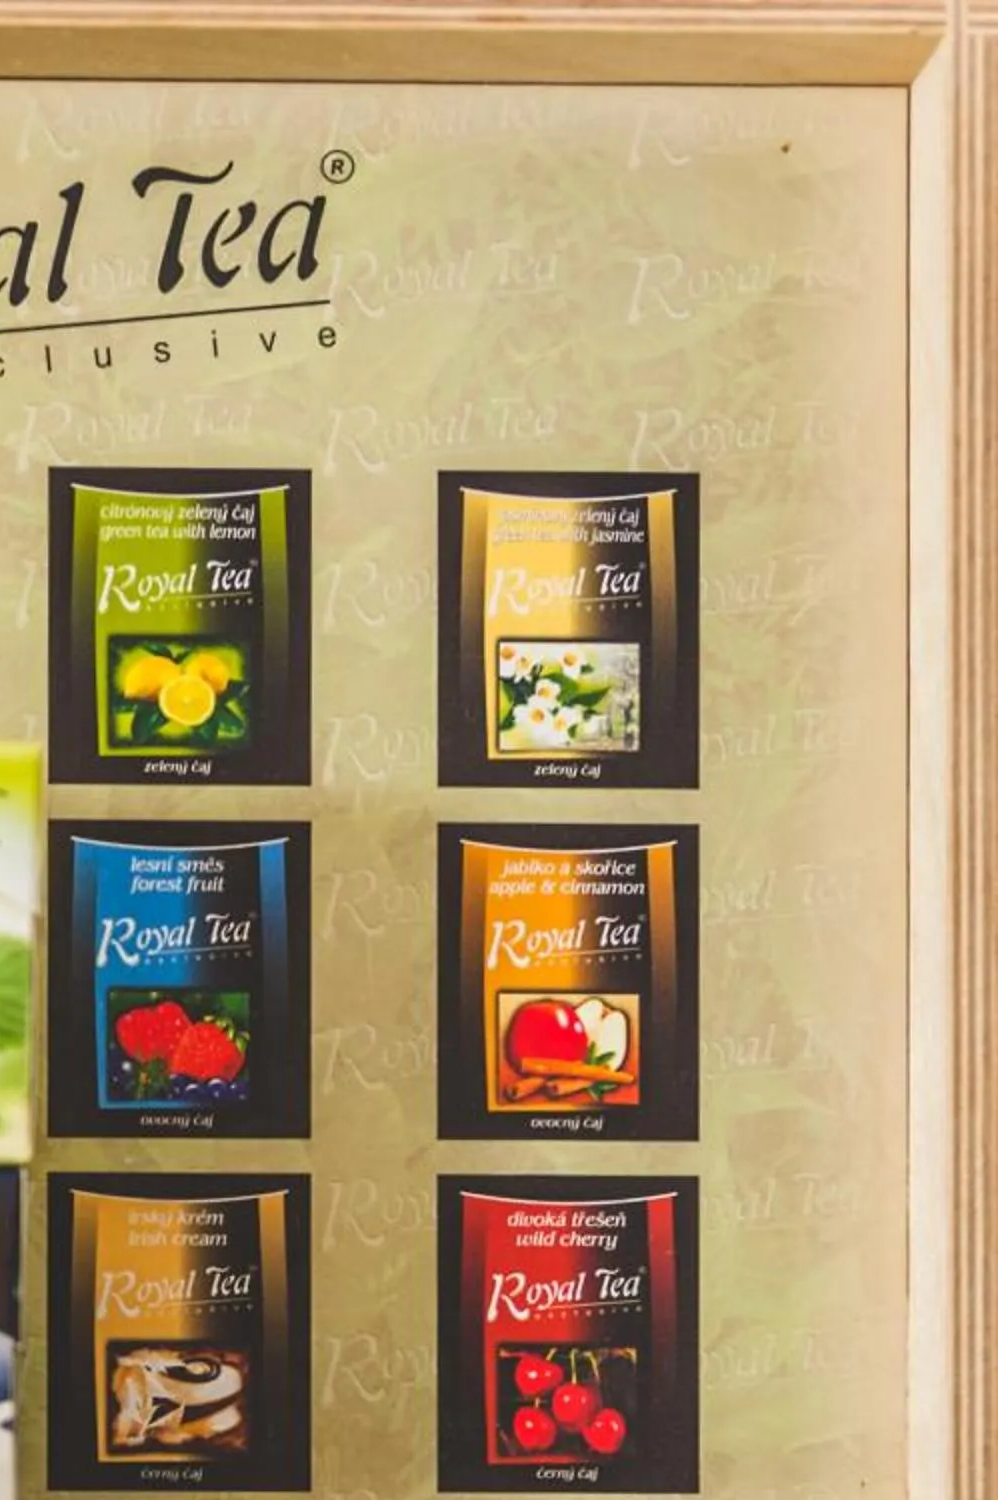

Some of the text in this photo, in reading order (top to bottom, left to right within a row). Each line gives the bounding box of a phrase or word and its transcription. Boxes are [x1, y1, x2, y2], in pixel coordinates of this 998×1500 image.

[131, 160, 326, 294] Tea
[178, 503, 228, 524] zelený
[232, 503, 256, 524] čaj
[619, 507, 641, 528] čaj
[100, 524, 256, 542] green tea with lemon
[589, 528, 645, 547] jasmine
[98, 560, 252, 614] Royal Tea
[487, 563, 642, 618] Royal Tea
[191, 760, 212, 775] čaj
[534, 763, 602, 779] zelený čaj
[130, 856, 225, 874] lesní směs
[501, 859, 636, 879] jablko a skořice
[130, 874, 225, 894] forest fruit
[489, 880, 537, 897] apple
[560, 880, 645, 896] cinnamon
[96, 913, 251, 968] Royal Tea
[487, 915, 642, 970] Royal Tea
[178, 1208, 225, 1226] krém
[507, 1211, 567, 1228] divoká
[172, 1232, 228, 1247] cream
[515, 1231, 618, 1251] wild cherry
[95, 1265, 252, 1321] Royal Tea
[487, 1267, 641, 1323] Royal Tea
[536, 1466, 599, 1482] černý čaj
